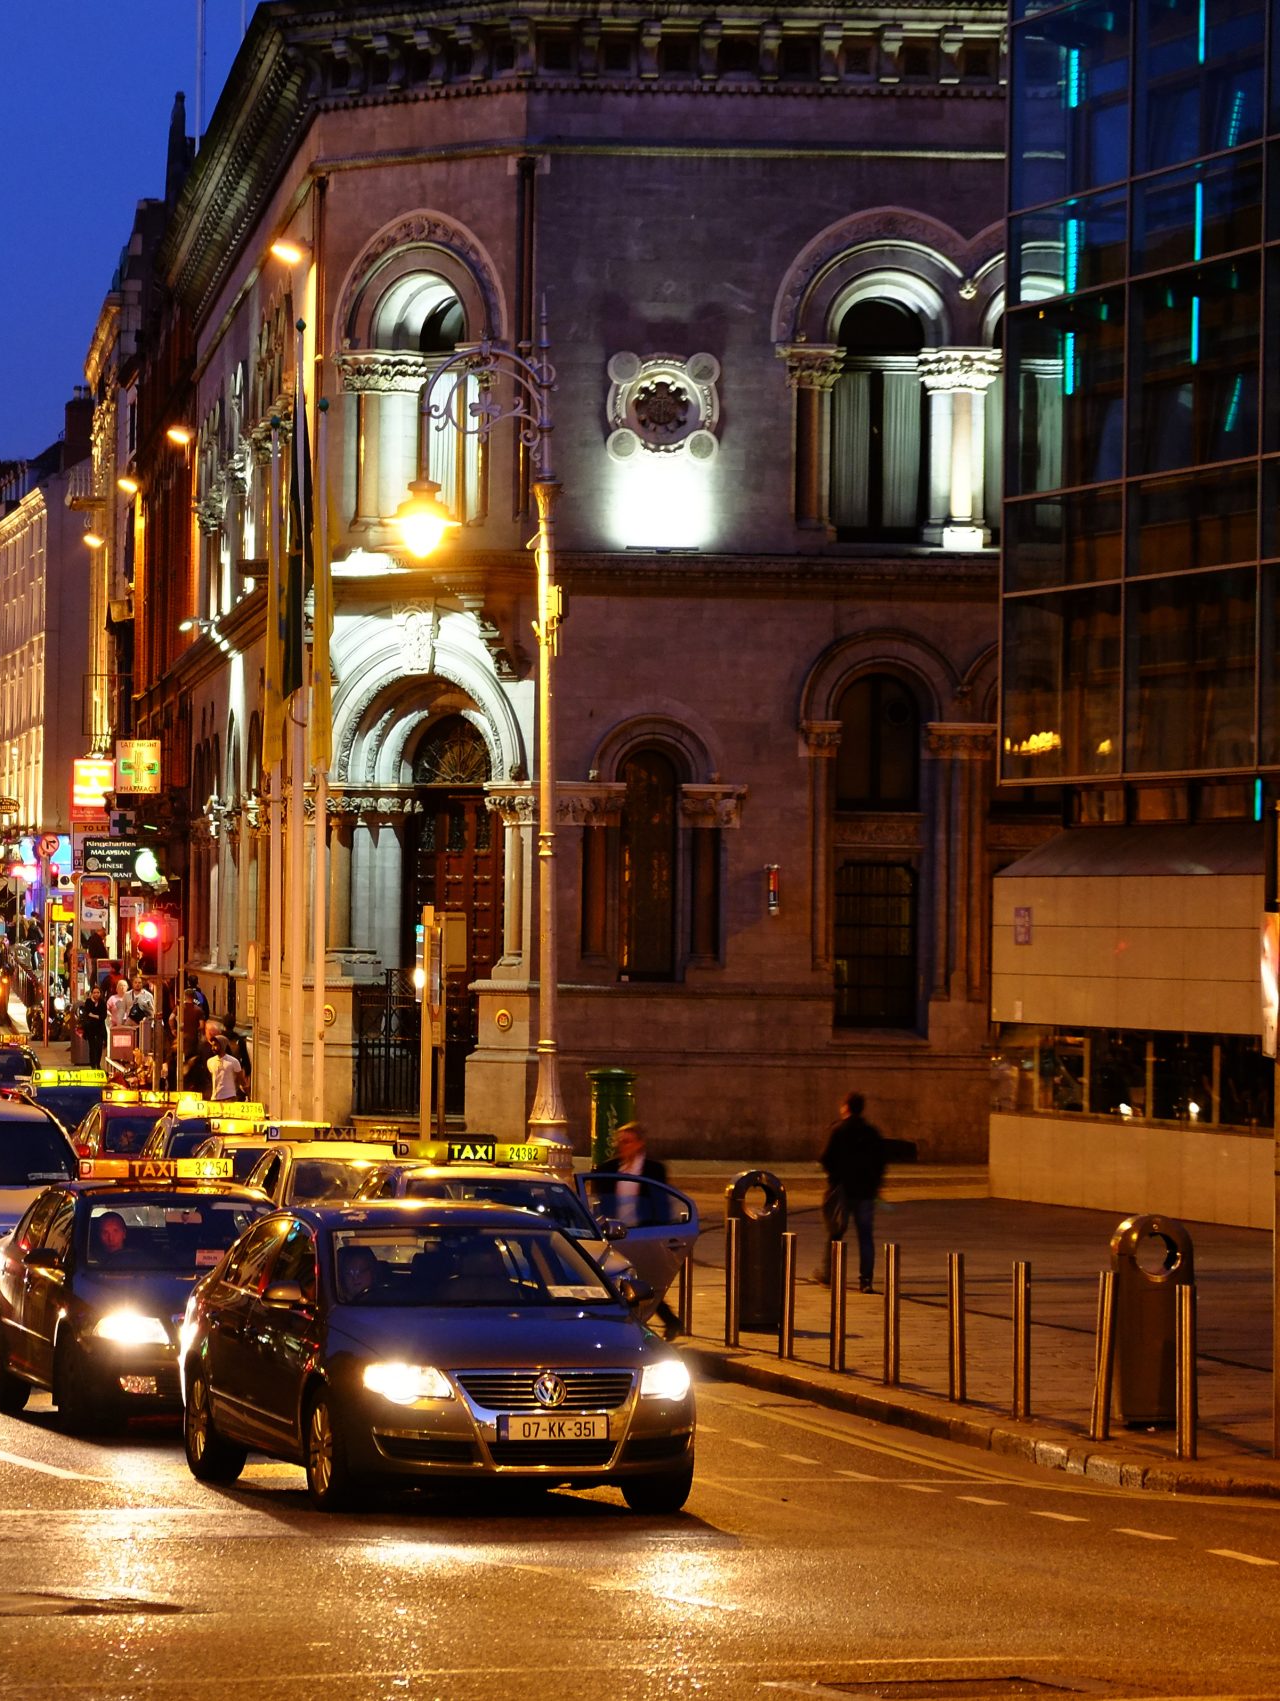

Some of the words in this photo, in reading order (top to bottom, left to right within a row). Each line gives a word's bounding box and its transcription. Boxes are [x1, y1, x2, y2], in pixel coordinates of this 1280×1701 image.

[34, 1071, 41, 1080] D
[105, 1091, 112, 1099] D
[140, 1091, 168, 1102] TAXI
[212, 1122, 220, 1130] D
[270, 1127, 279, 1137] D
[318, 1129, 354, 1140] TAXI
[399, 1143, 409, 1155] D
[451, 1144, 493, 1160] TAXI
[509, 1147, 538, 1160] 24382
[80, 1161, 92, 1174] D
[132, 1161, 177, 1177] TAXI
[195, 1161, 229, 1176] 32254
